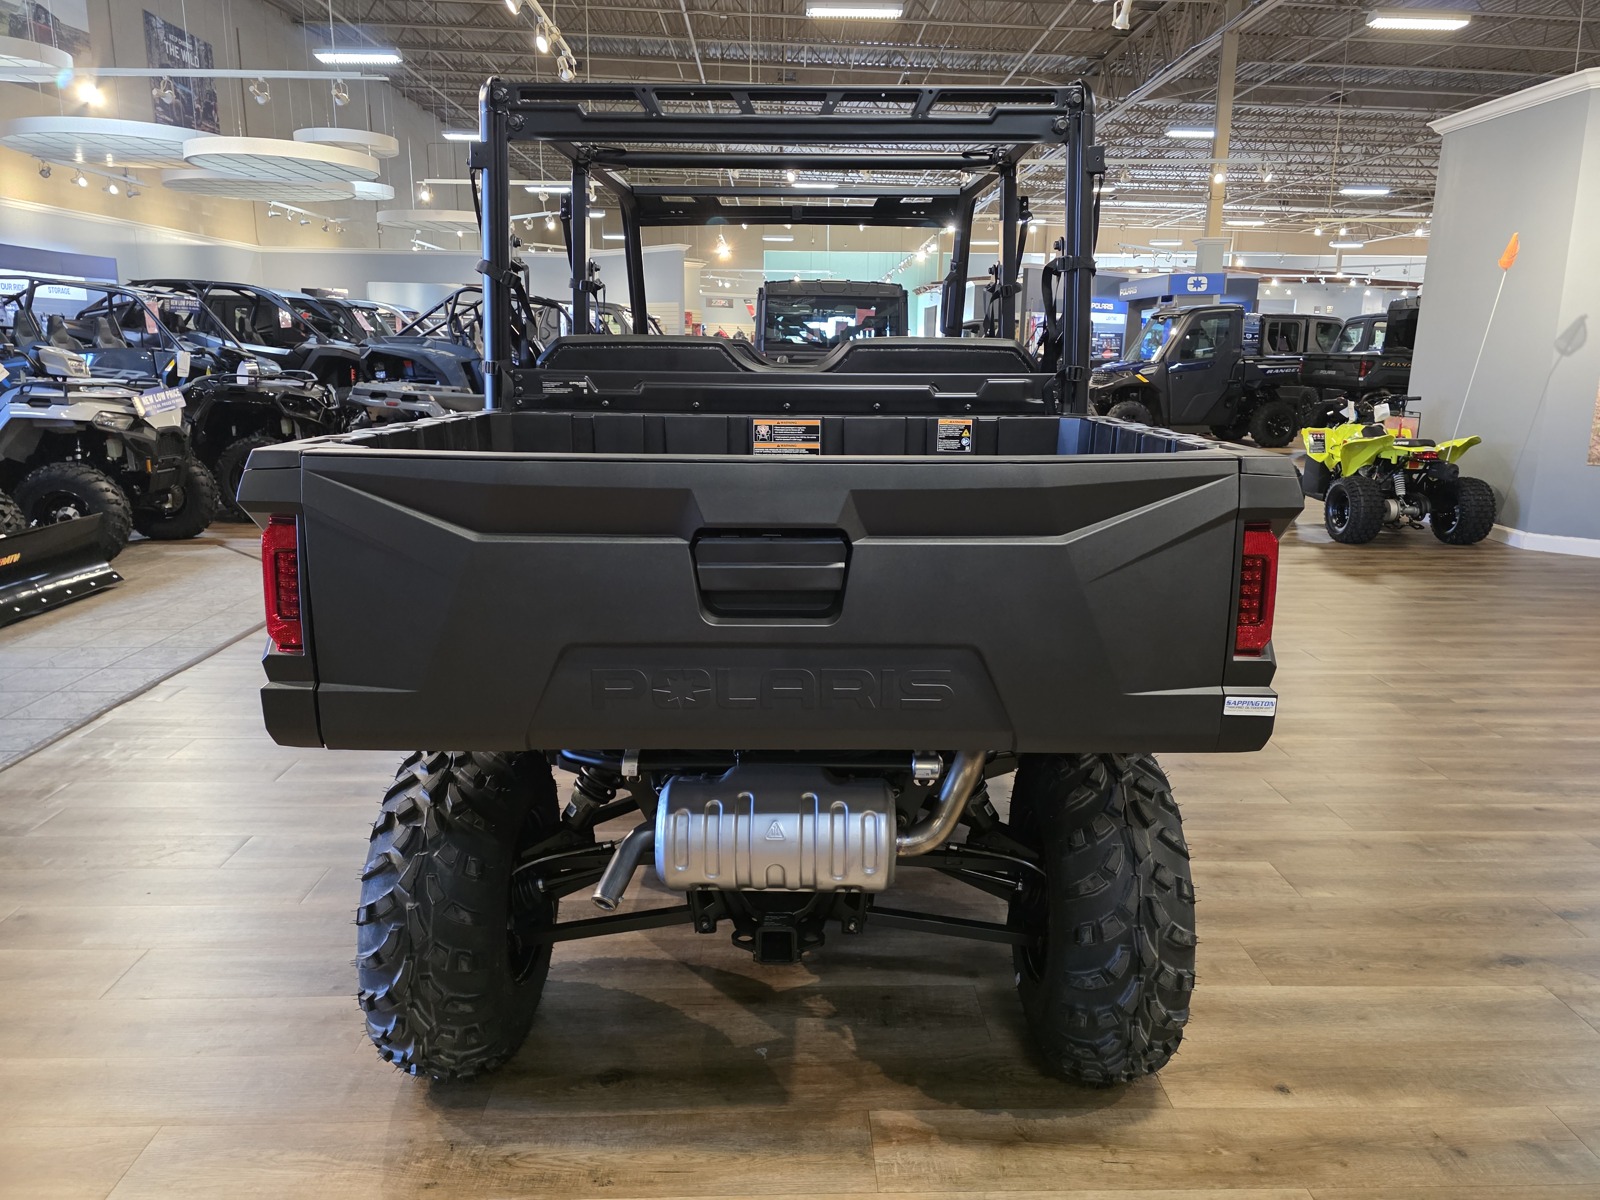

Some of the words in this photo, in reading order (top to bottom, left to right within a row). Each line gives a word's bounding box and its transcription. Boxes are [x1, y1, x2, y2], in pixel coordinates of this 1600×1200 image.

[163, 41, 180, 59] THE
[180, 49, 200, 68] WILD
[0, 282, 13, 291] OUR
[48, 286, 71, 296] STORAGE
[1119, 286, 1138, 297] POLARIS
[1091, 302, 1114, 310] POLARIS
[141, 394, 154, 406] NEW
[153, 391, 166, 403] LOW
[165, 388, 181, 400] PRICE
[590, 668, 956, 712] POLARIS
[1226, 699, 1276, 708] SAPPINGTON
